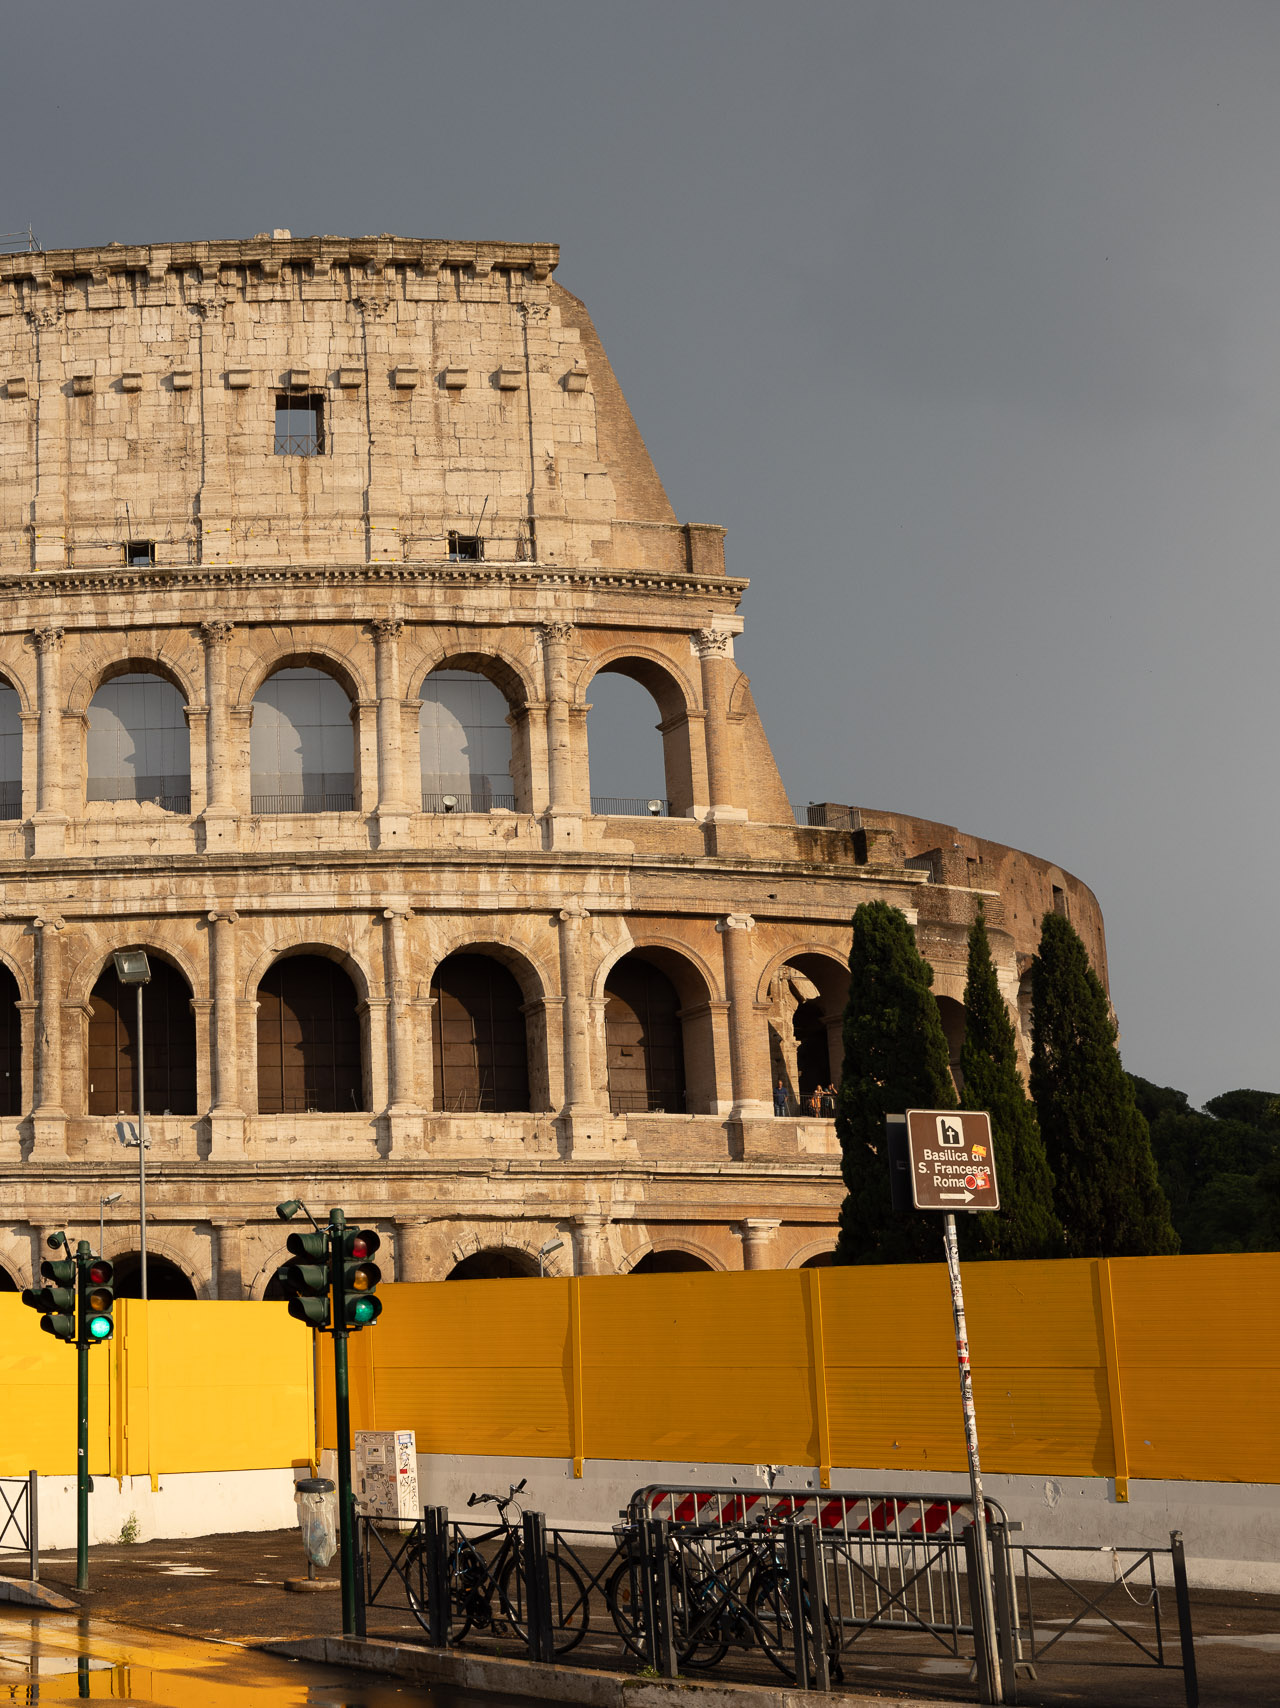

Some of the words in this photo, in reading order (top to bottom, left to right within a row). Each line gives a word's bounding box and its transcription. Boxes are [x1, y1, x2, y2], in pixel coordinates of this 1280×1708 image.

[923, 1148, 969, 1162] Basilica
[918, 1162, 931, 1174] S.
[934, 1162, 991, 1175] Francesca
[933, 1175, 967, 1188] Roma
